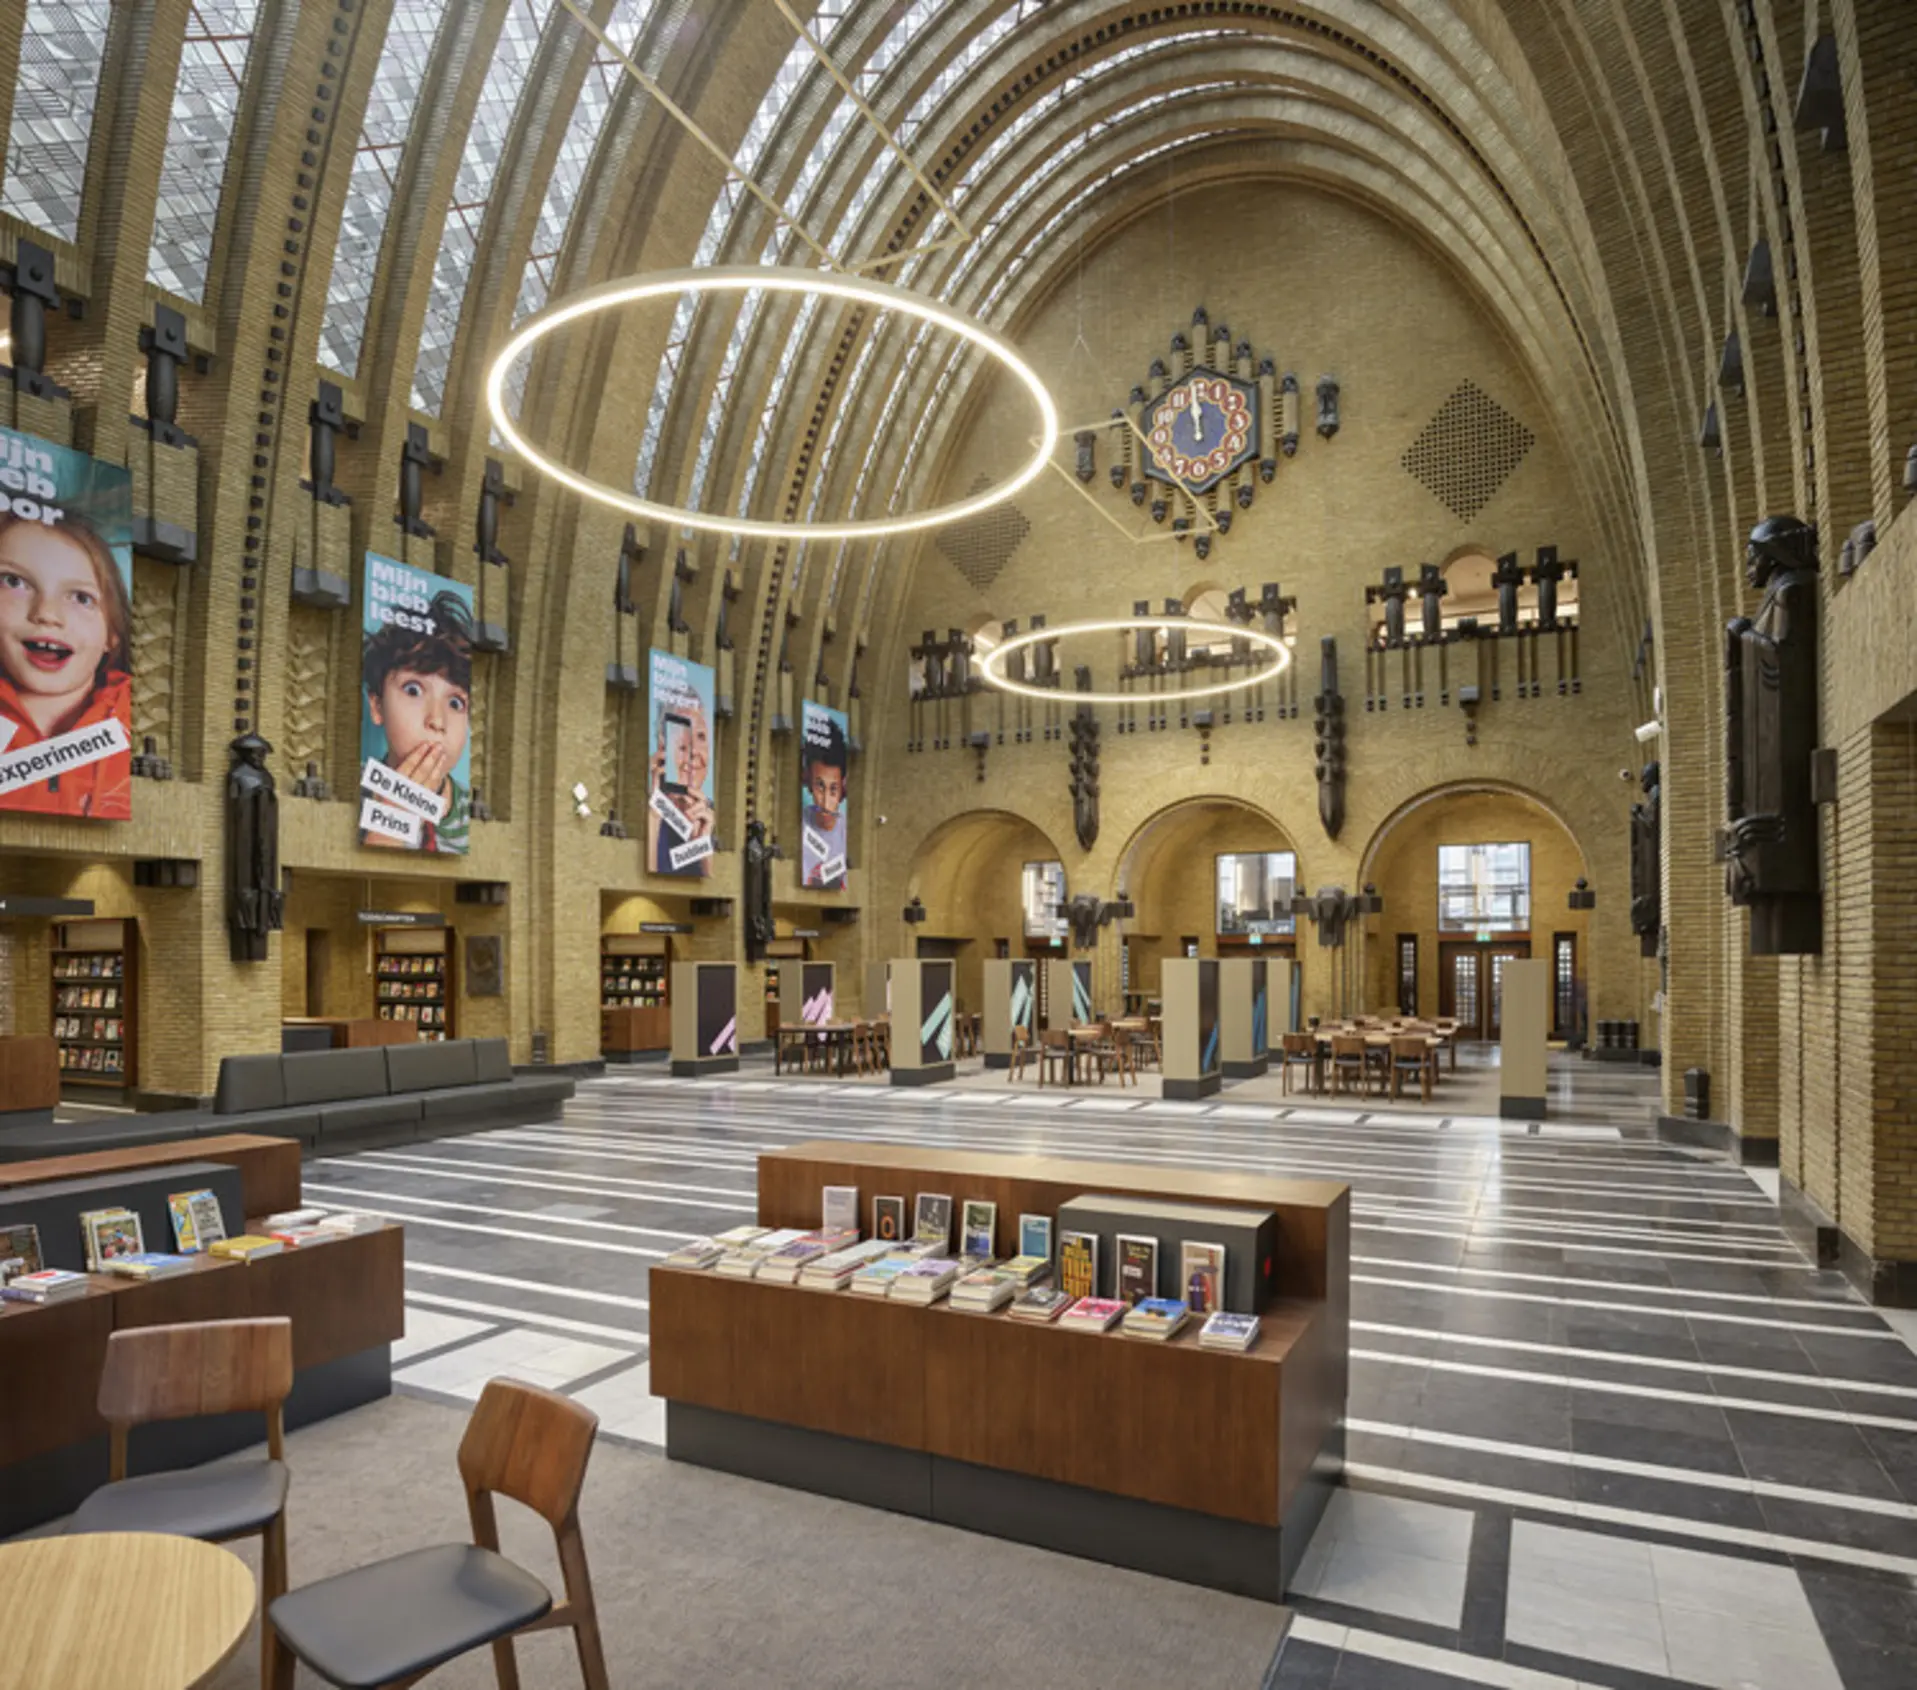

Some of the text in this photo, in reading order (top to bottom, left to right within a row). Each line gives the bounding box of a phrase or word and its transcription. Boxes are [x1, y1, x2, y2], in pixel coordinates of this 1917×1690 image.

[372, 561, 427, 594] Mijn
[371, 580, 430, 615] bieb
[370, 600, 437, 635] leest
[0, 728, 116, 785] xperiment
[370, 768, 438, 816] De Kleine
[371, 808, 410, 834] Prins
